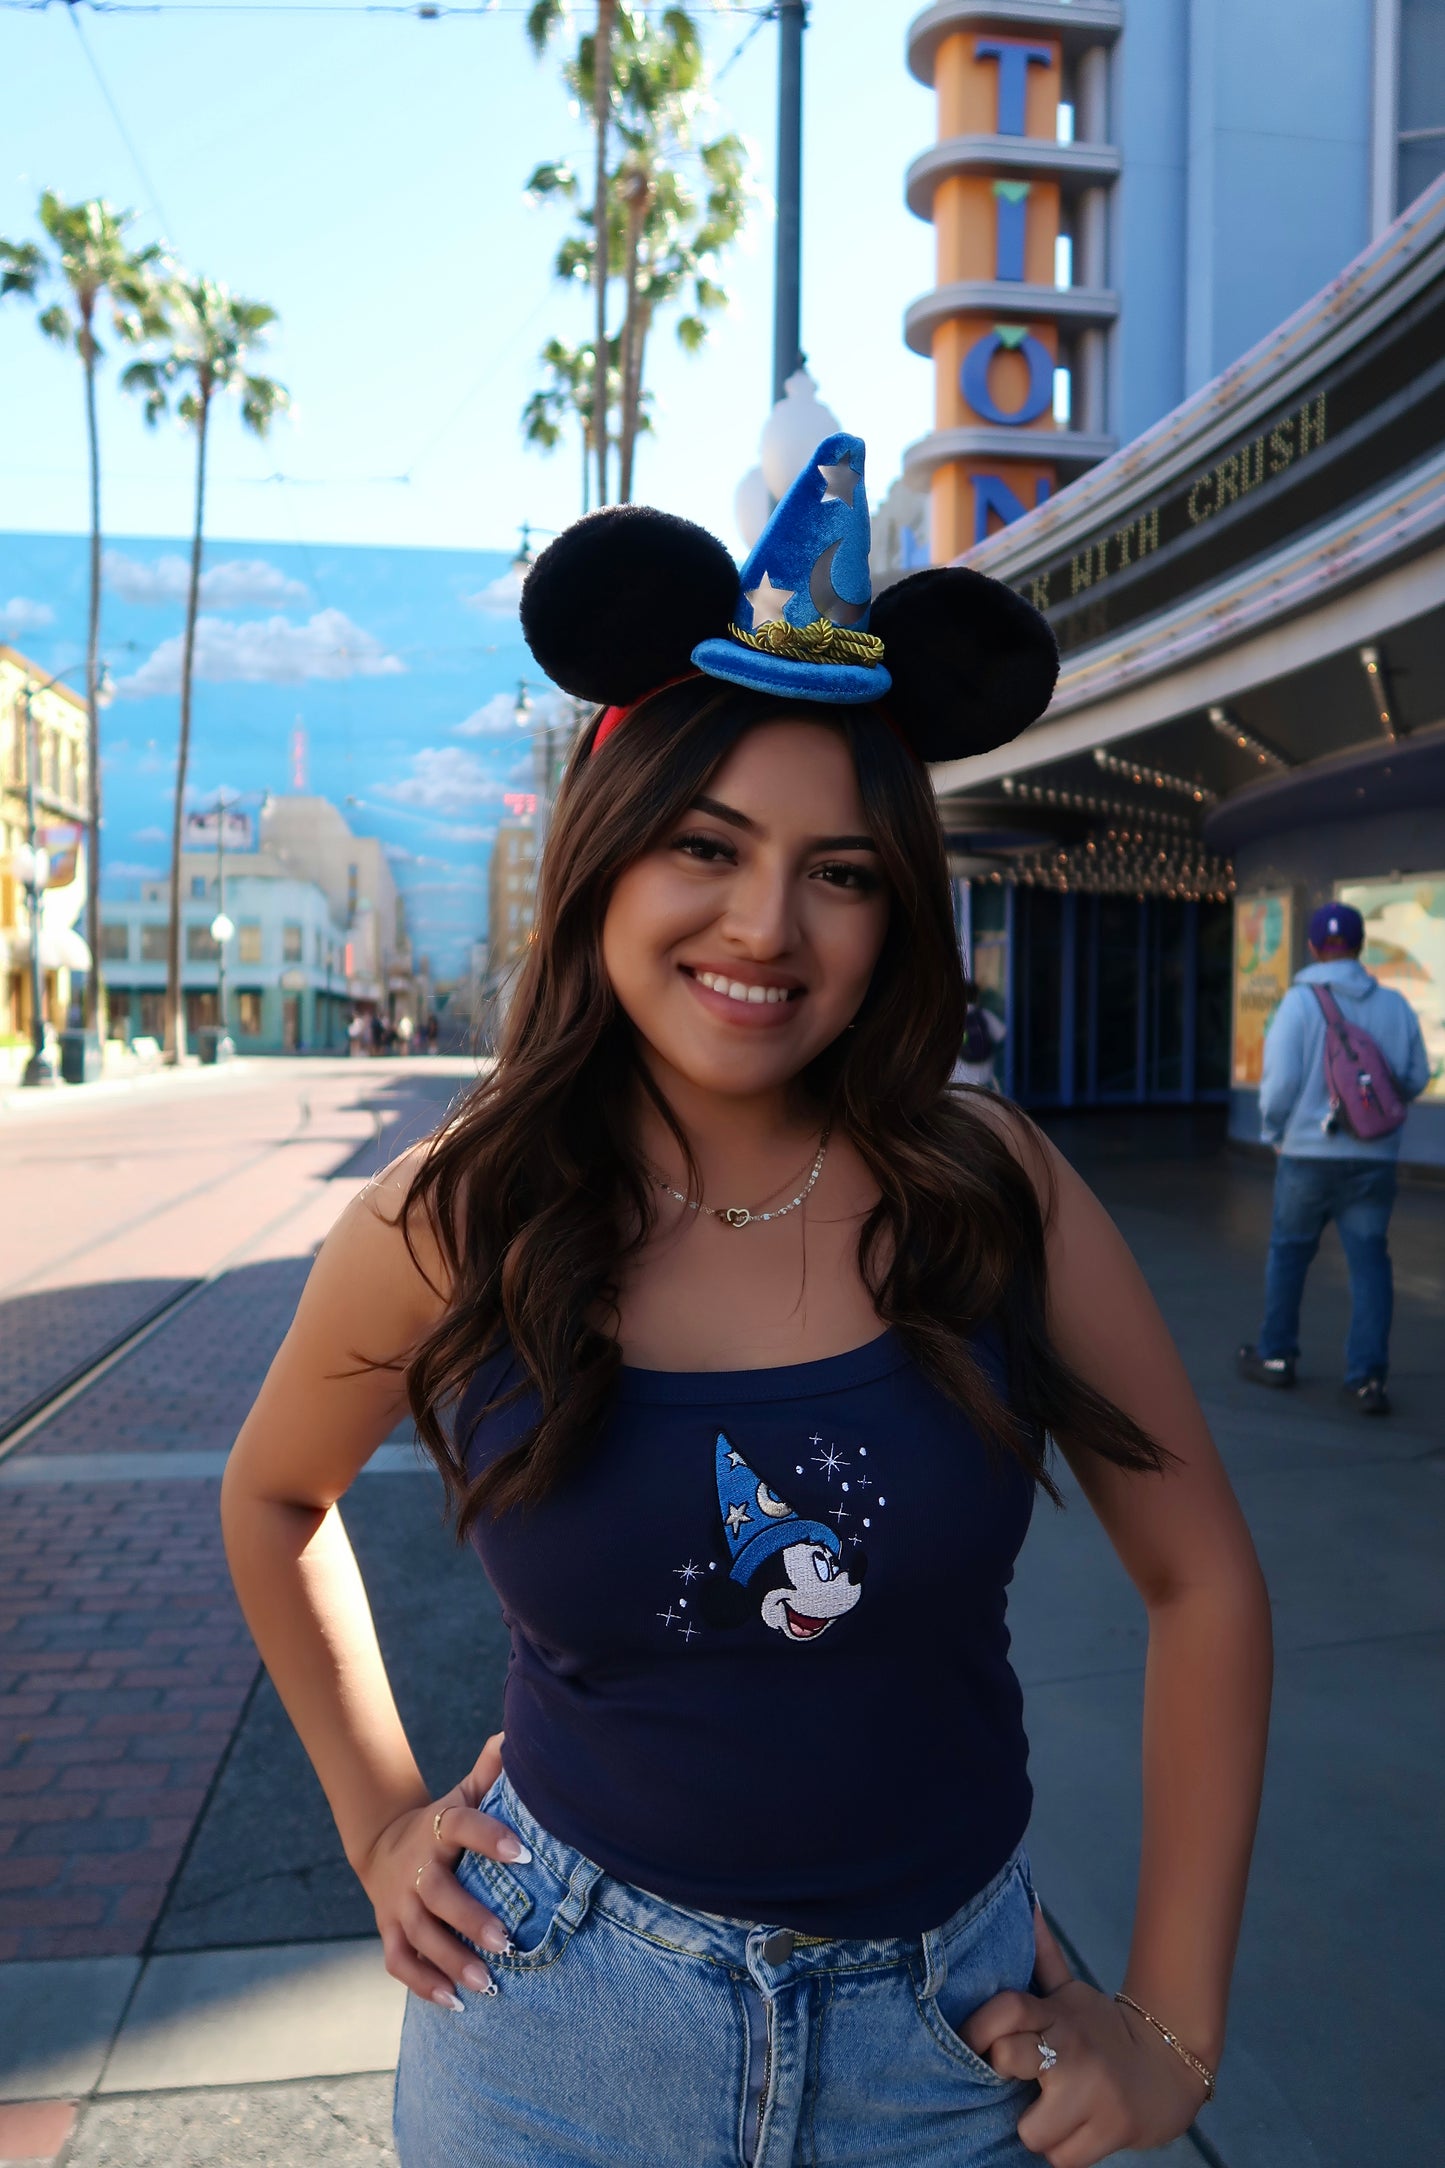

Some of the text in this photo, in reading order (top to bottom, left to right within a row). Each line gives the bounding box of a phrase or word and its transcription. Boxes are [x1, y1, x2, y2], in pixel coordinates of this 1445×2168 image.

[1015, 391, 1326, 612] K WITH CRUSH
